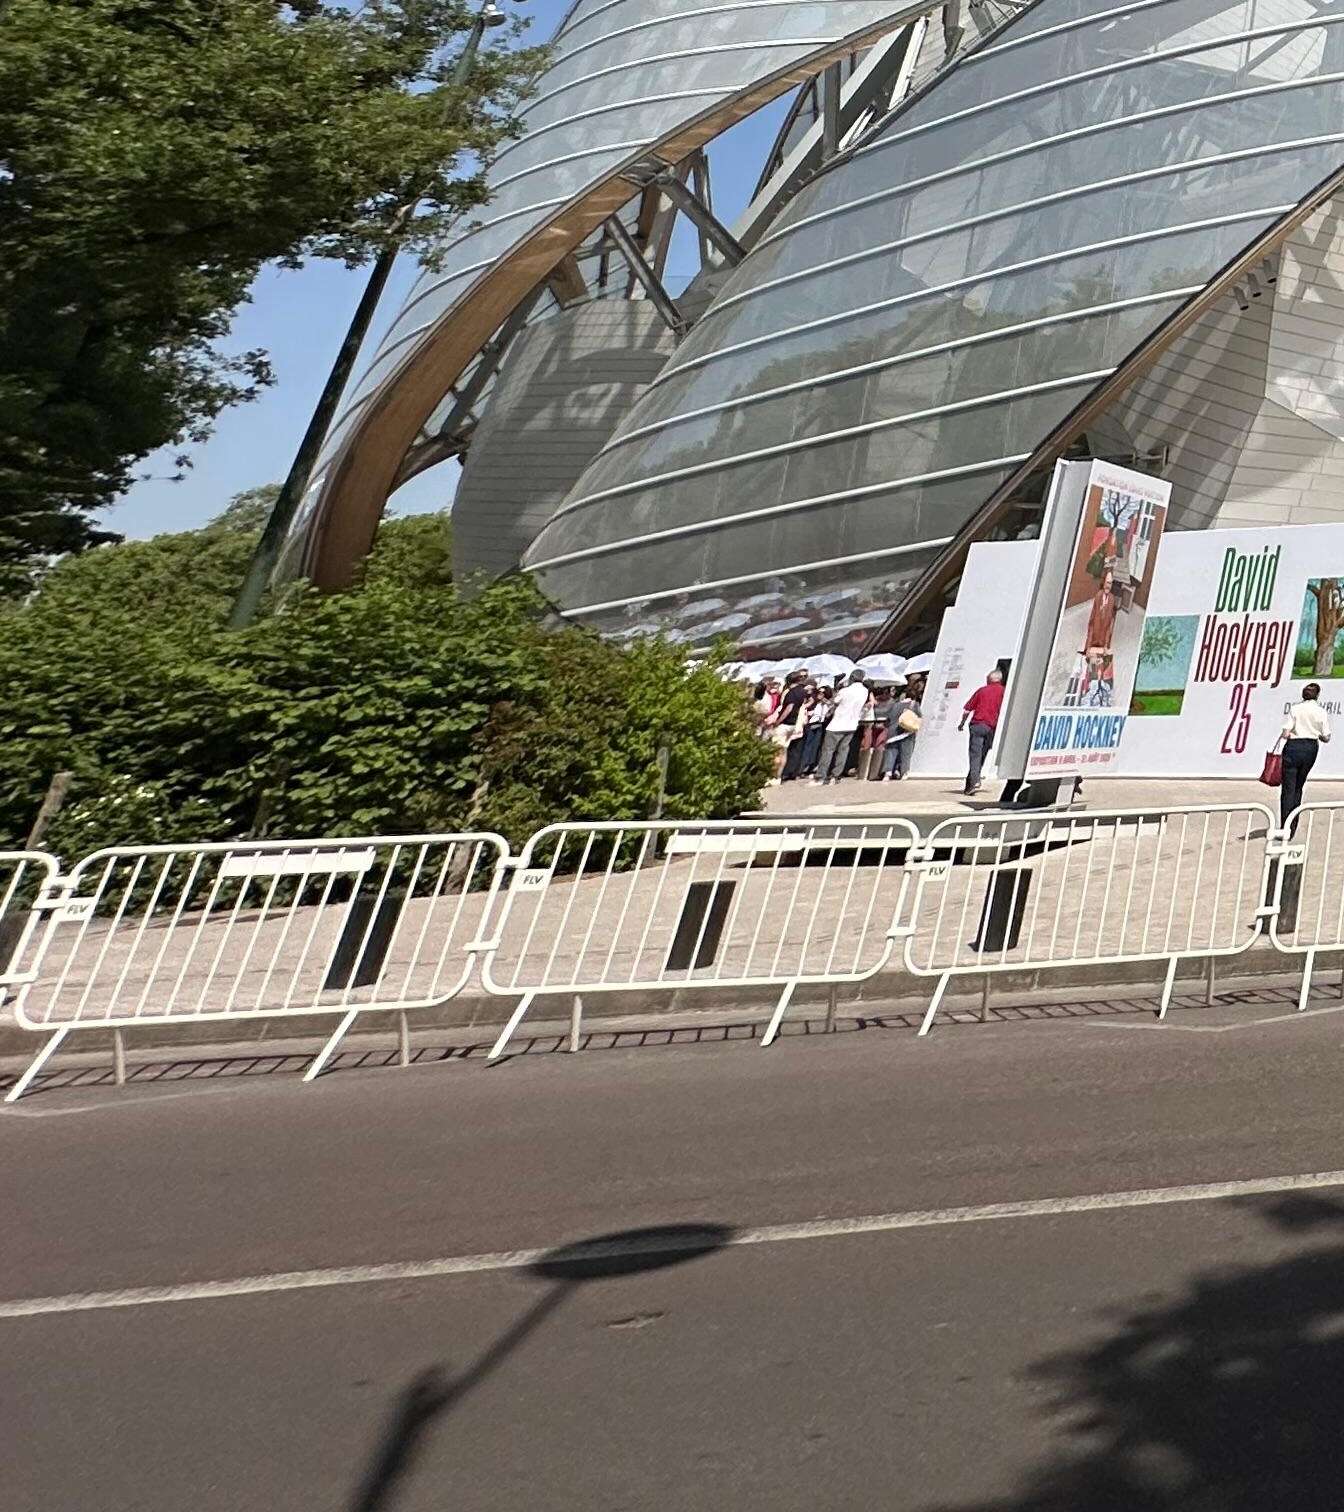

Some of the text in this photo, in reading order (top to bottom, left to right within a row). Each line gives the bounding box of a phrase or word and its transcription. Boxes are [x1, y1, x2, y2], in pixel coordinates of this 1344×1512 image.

[1214, 544, 1281, 613] David
[1194, 613, 1294, 689] Hockney
[1220, 683, 1258, 754] 25
[1033, 715, 1128, 751] DAVID HOCKNEY
[1288, 850, 1303, 859] FLV
[523, 875, 544, 885] FLV
[929, 866, 947, 876] FLV
[67, 904, 89, 915] FLV
